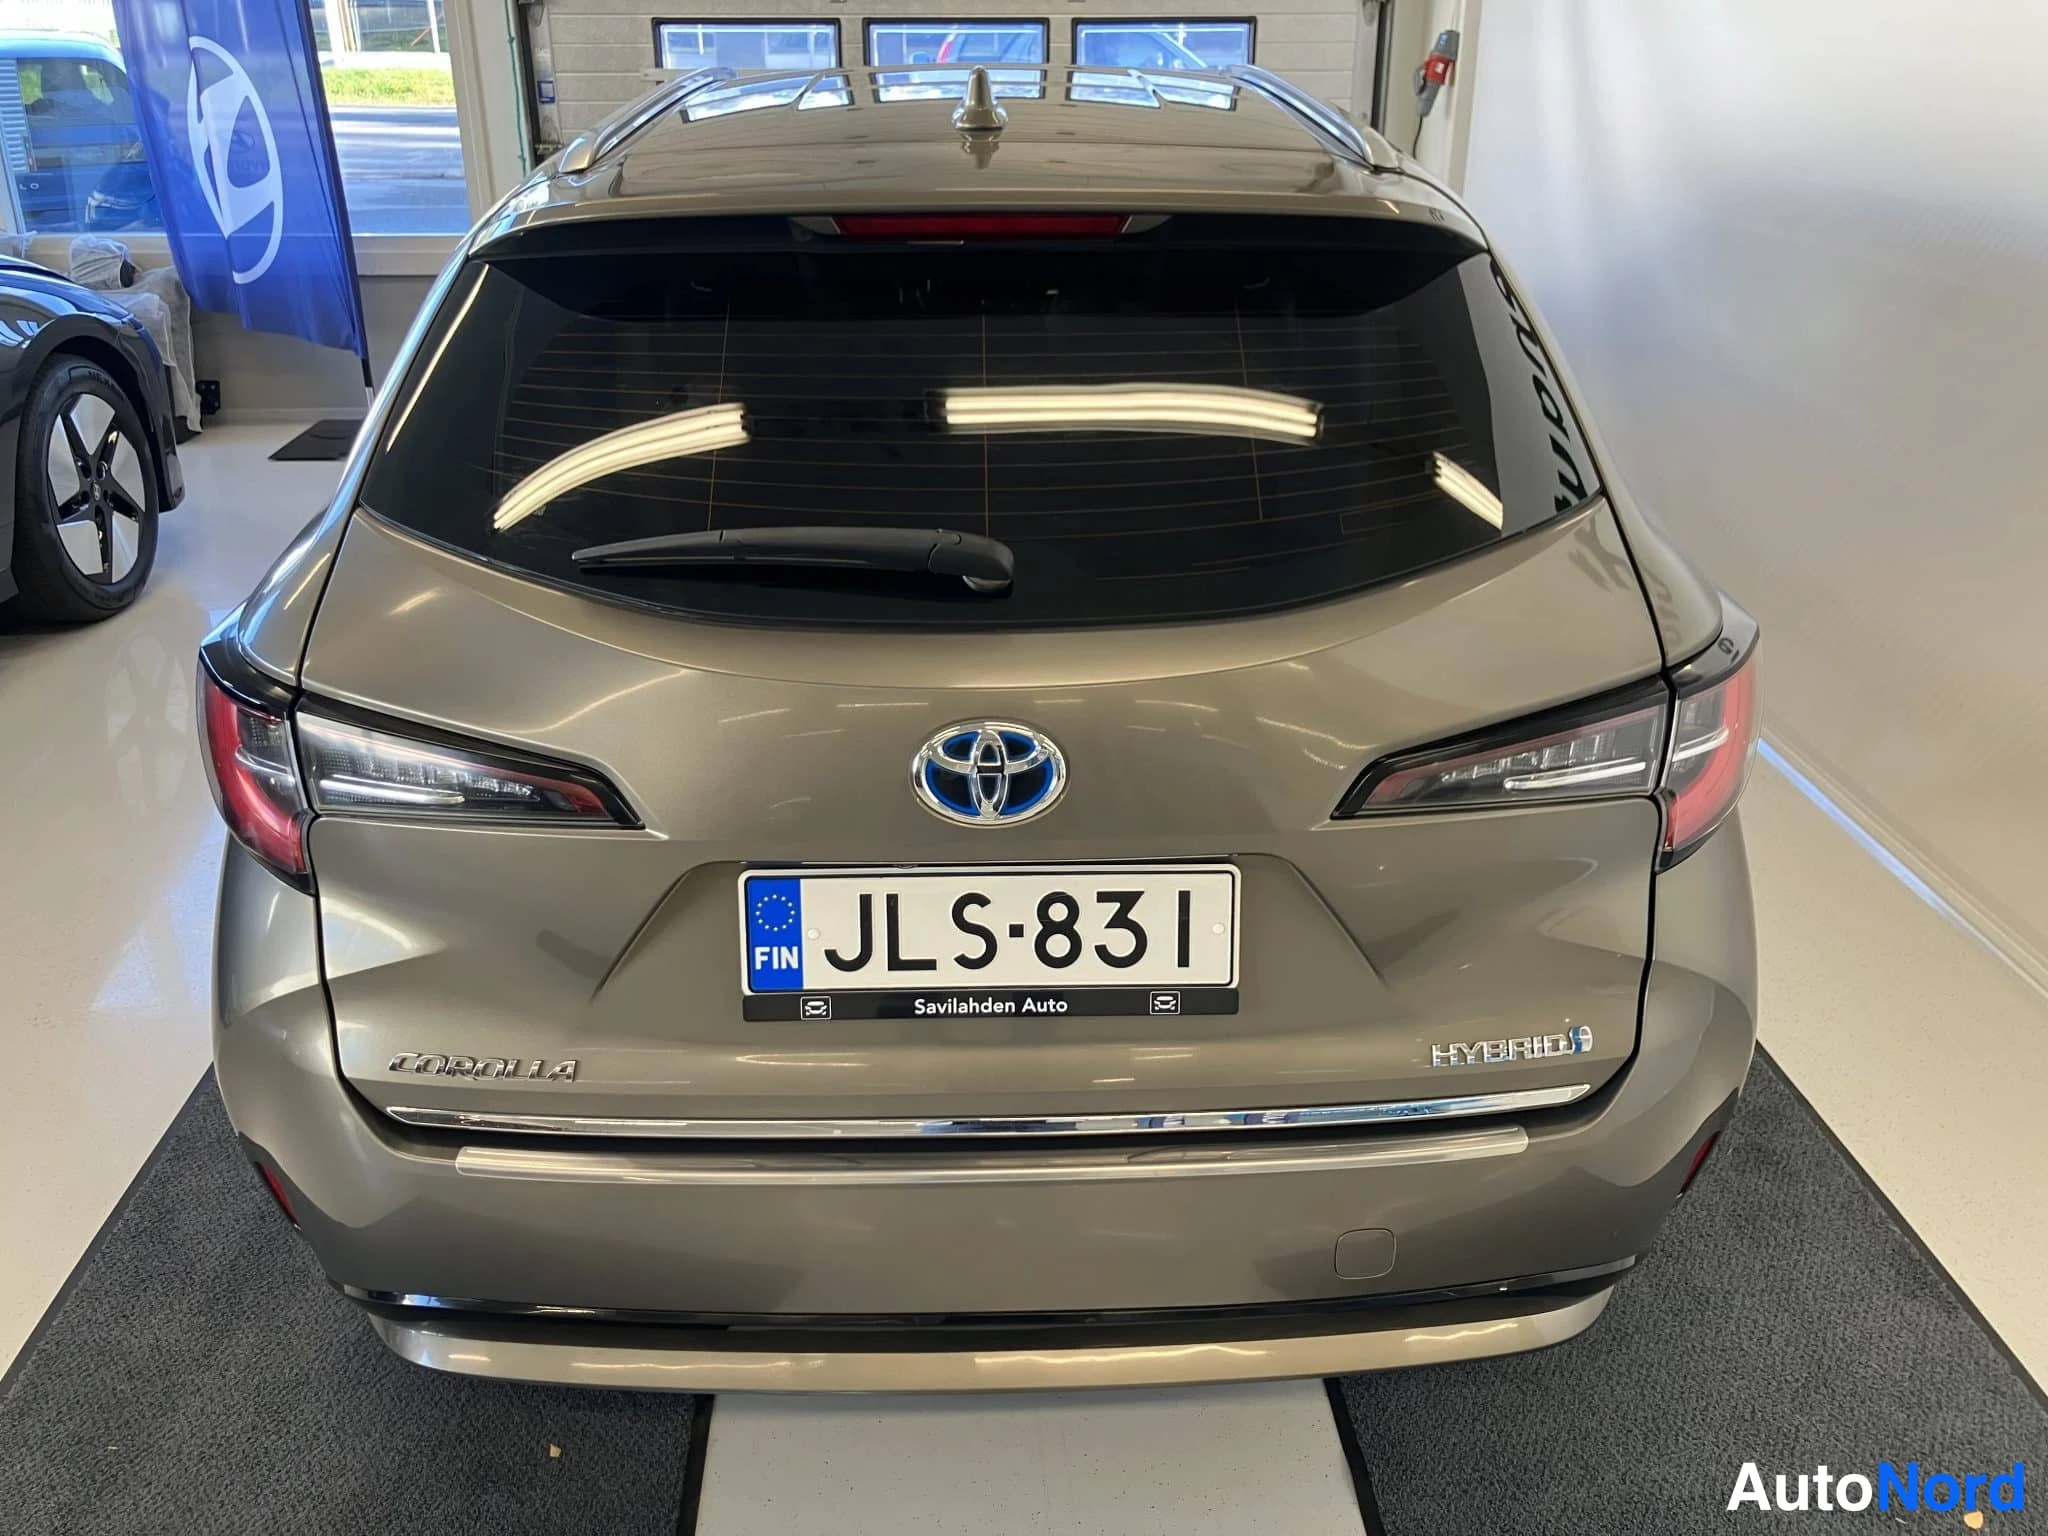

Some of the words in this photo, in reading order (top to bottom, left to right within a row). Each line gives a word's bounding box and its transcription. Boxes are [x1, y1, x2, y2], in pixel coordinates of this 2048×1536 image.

[823, 890, 1190, 972] JLS-831
[754, 946, 799, 970] FIN
[914, 997, 1016, 1015] Savilahden
[1021, 997, 1068, 1013] Auto
[1431, 1033, 1571, 1067] HYBRID
[388, 1052, 578, 1082] COROLLA
